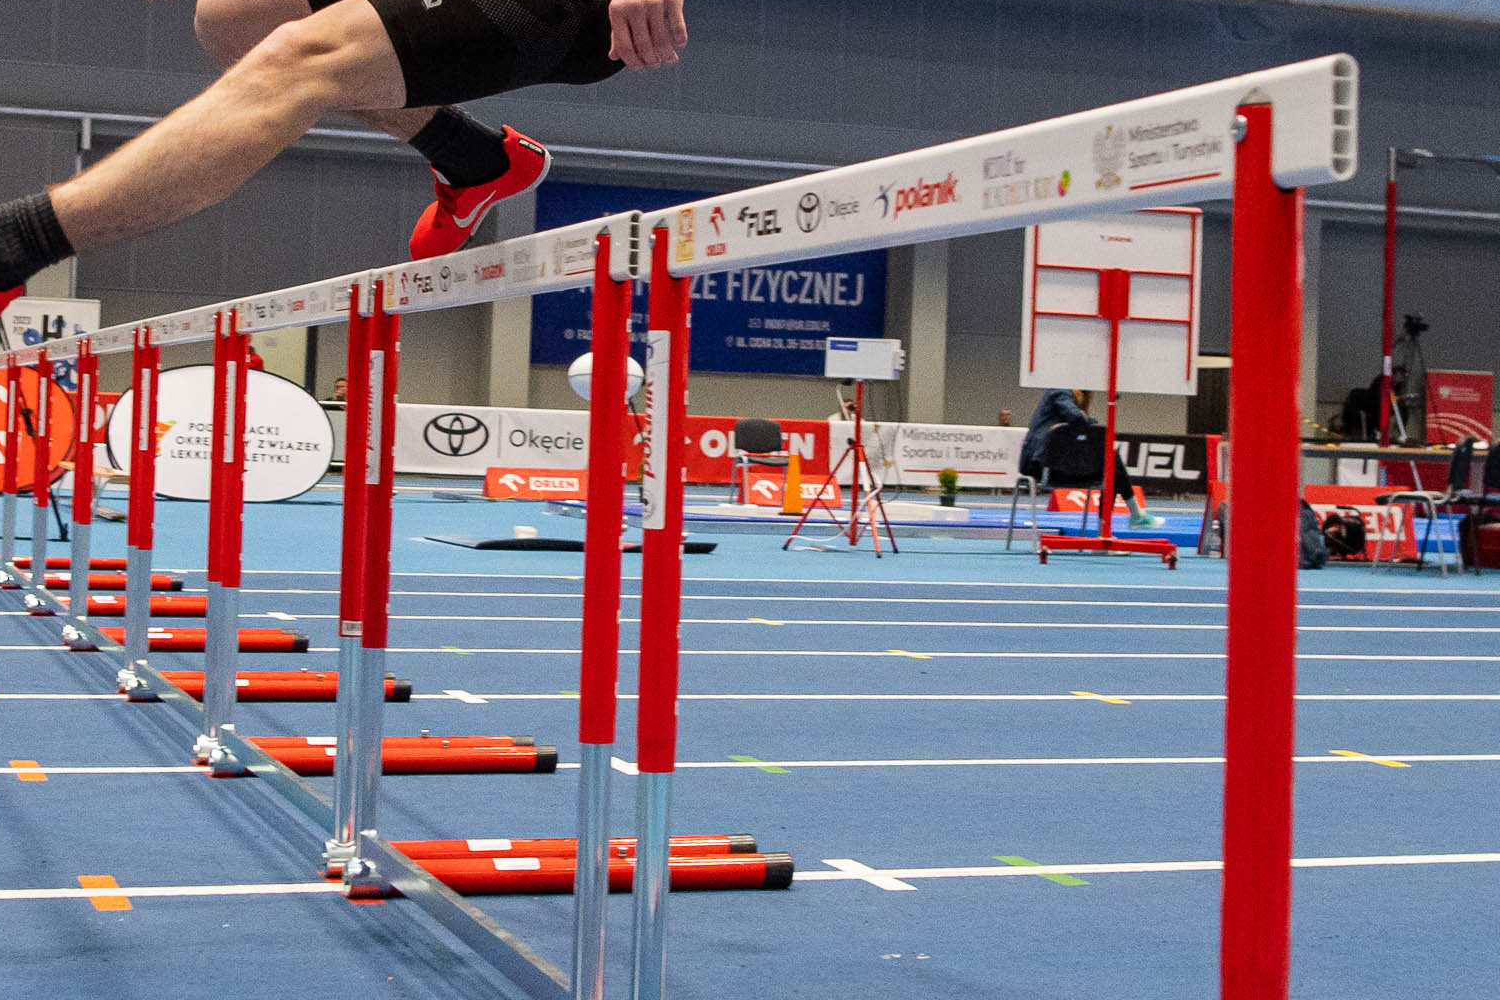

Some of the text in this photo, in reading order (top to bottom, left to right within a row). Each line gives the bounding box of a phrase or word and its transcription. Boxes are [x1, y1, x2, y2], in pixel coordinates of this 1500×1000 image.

[893, 171, 959, 220] polanik
[725, 269, 865, 307] FIZYCZNEJ
[508, 429, 584, 455] Okęcie
[902, 429, 983, 443] Ministerstwo
[902, 445, 941, 462] Sportu
[954, 446, 1009, 463] Turystyki
[1116, 441, 1201, 480] UEL
[533, 479, 574, 492] ORLEN
